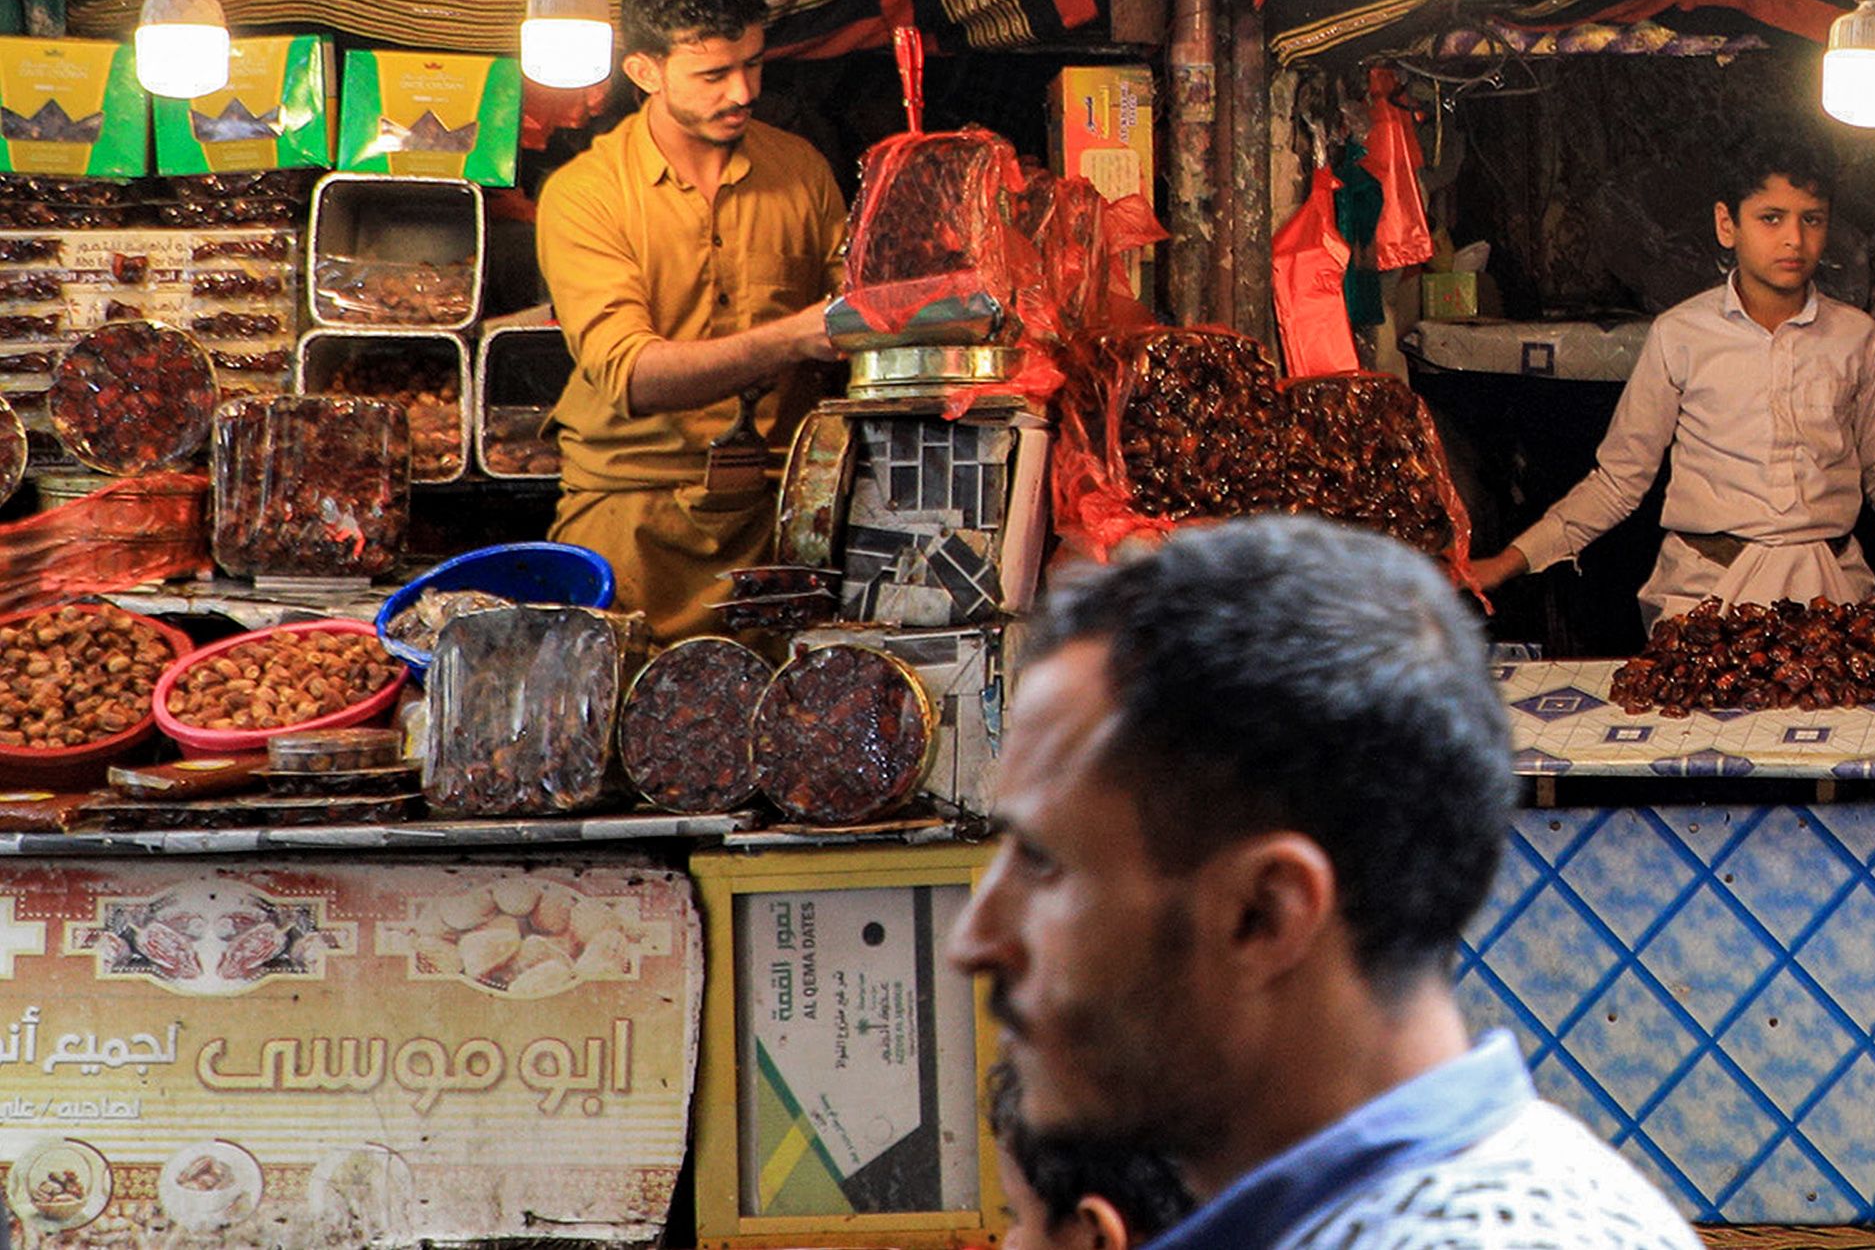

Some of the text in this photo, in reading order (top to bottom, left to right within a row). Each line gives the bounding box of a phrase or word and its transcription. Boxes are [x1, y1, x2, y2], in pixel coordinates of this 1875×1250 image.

[769, 901, 797, 1022] تمور القمة
[801, 901, 818, 1021] AL QEMA DATES
[43, 1023, 180, 1075] لجميع
[518, 1017, 633, 1118] ابو
